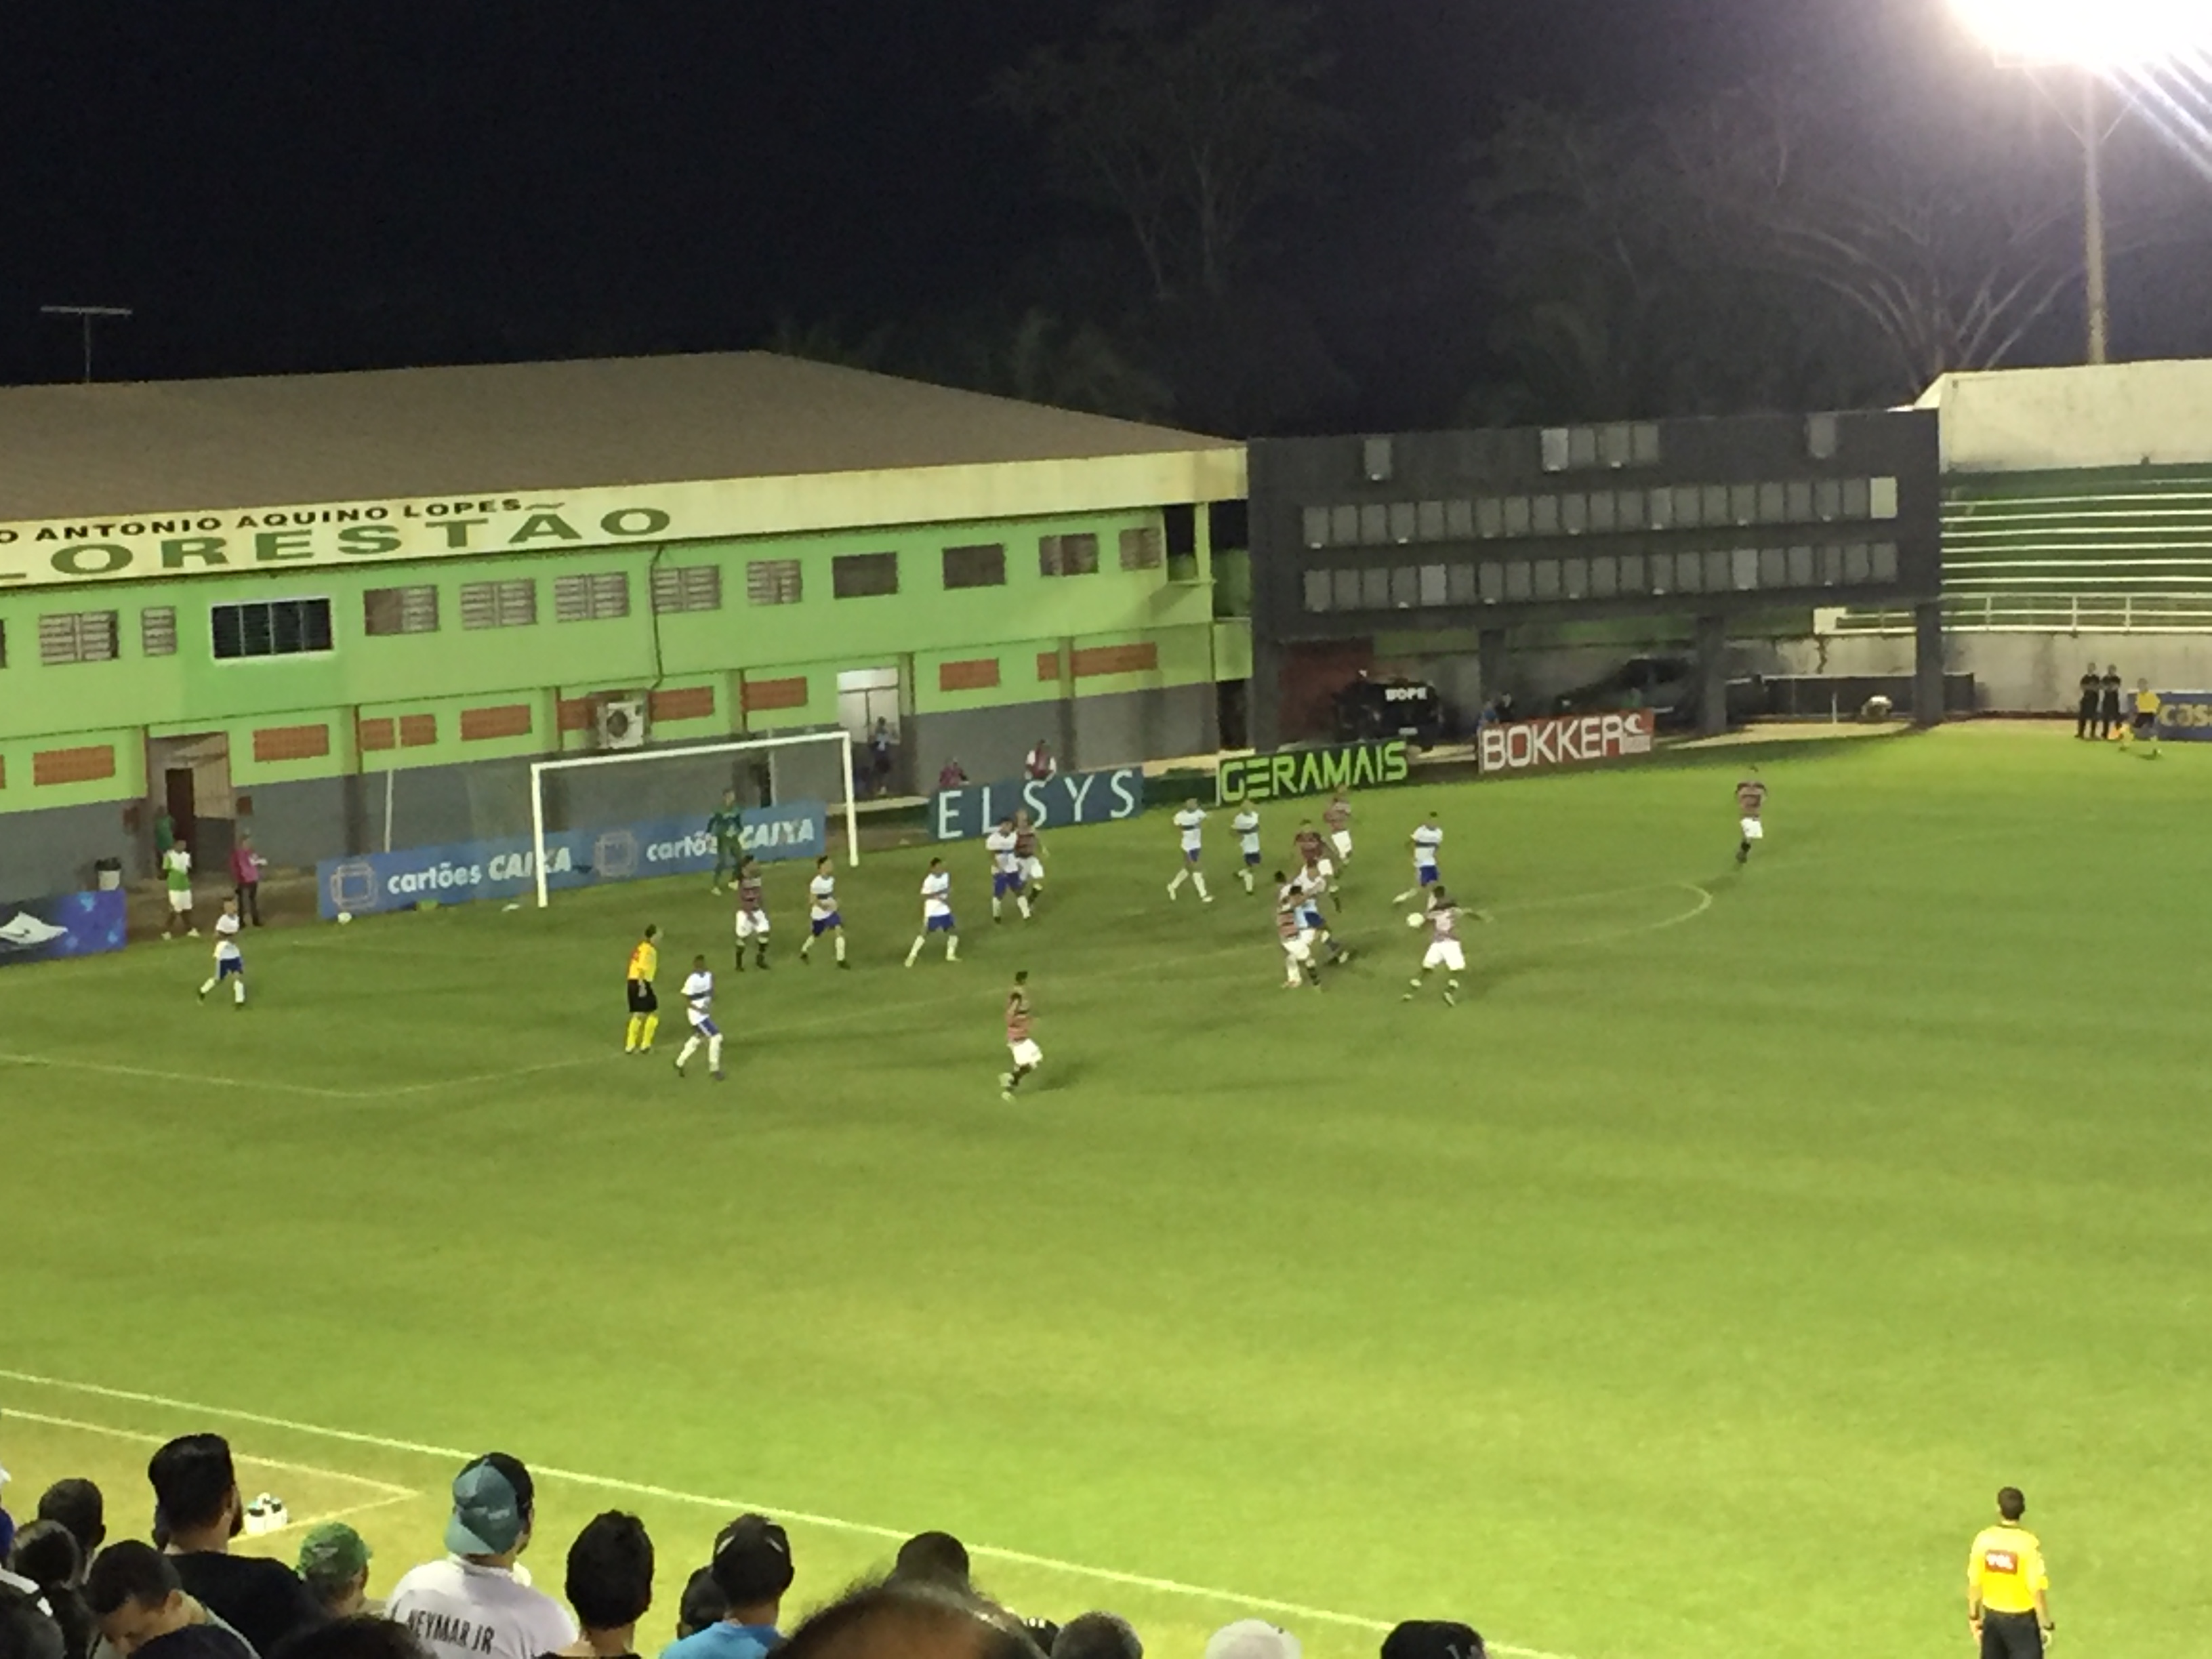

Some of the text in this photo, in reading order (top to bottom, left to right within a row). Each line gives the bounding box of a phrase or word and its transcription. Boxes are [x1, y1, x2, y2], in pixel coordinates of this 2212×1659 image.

[35, 517, 222, 541] ANTONIO
[236, 507, 388, 528] AQUINO
[403, 499, 521, 517] LOPES
[1221, 741, 1408, 802] GERAMAIS
[938, 769, 1134, 840] ELSYS
[646, 818, 815, 862] cartõe CAIXA
[387, 861, 483, 895] cartões
[407, 1609, 495, 1655] NEYMAR JR
